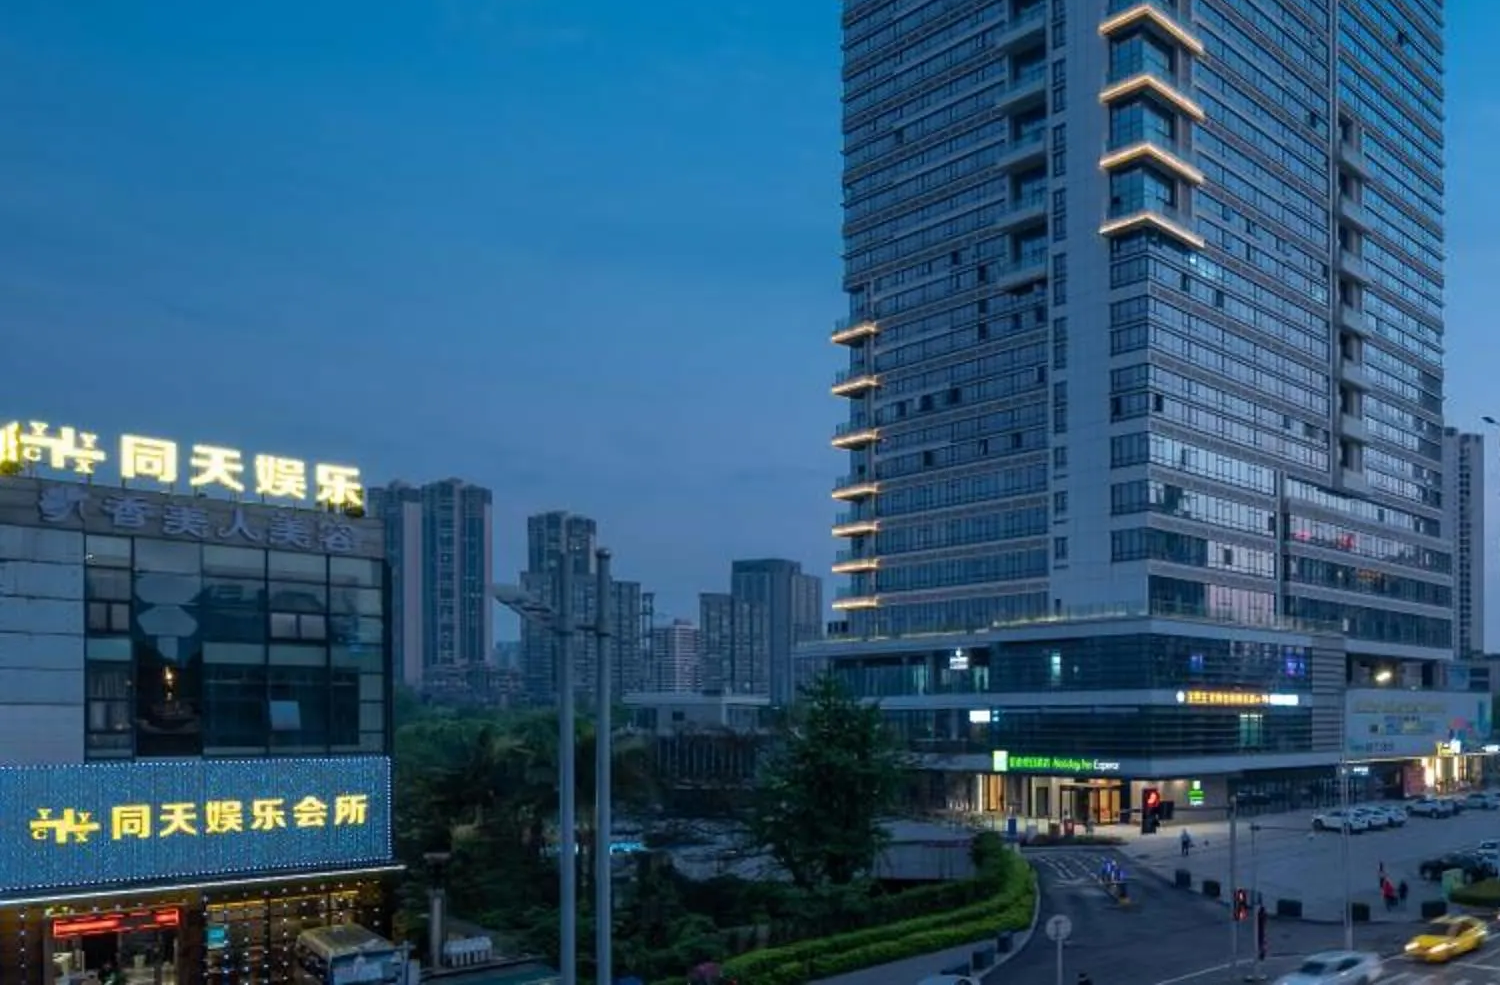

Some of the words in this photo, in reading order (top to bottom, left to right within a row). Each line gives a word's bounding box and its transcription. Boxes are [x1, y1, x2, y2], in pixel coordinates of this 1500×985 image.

[119, 433, 364, 507] 同天娱乐
[111, 794, 369, 840] 同天娱乐会所
